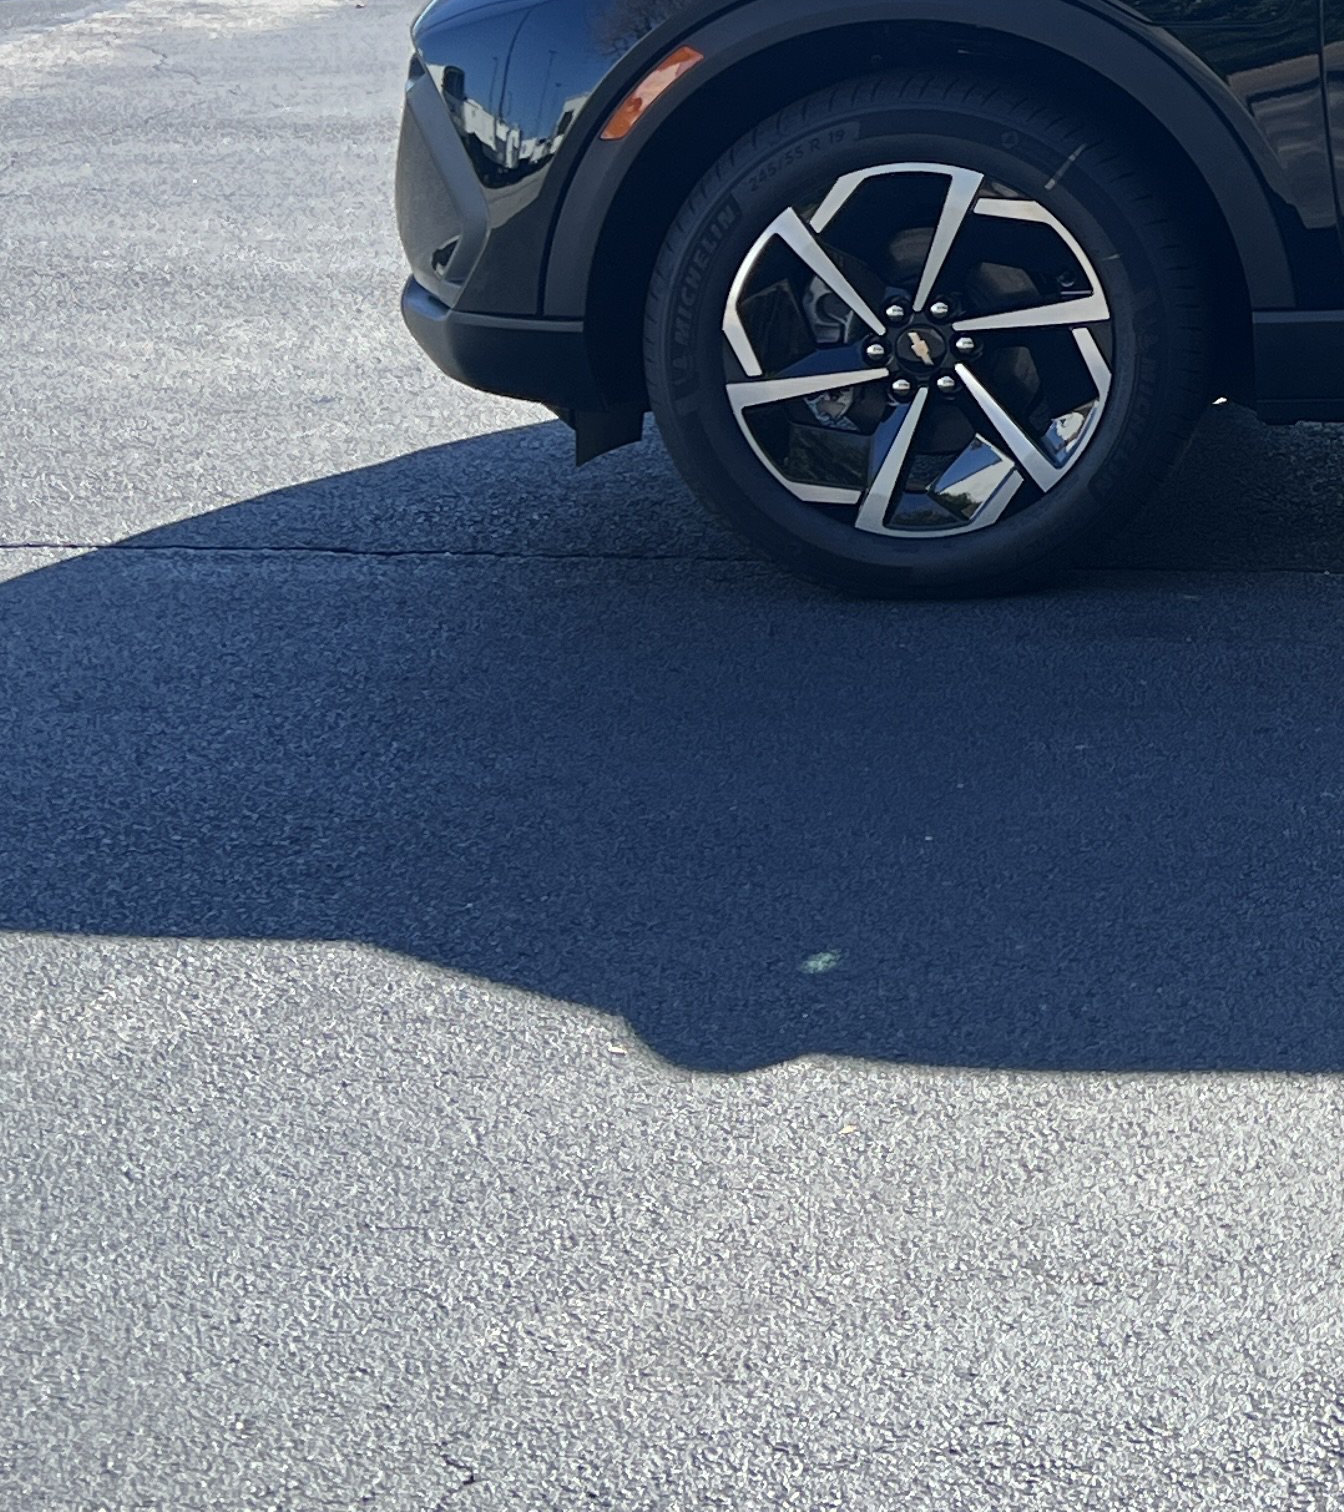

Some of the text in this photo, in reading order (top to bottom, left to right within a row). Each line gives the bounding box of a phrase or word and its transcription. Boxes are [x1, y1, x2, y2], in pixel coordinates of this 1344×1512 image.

[809, 136, 821, 152] R
[828, 128, 845, 144] 19
[674, 203, 737, 346] MICHELIN
